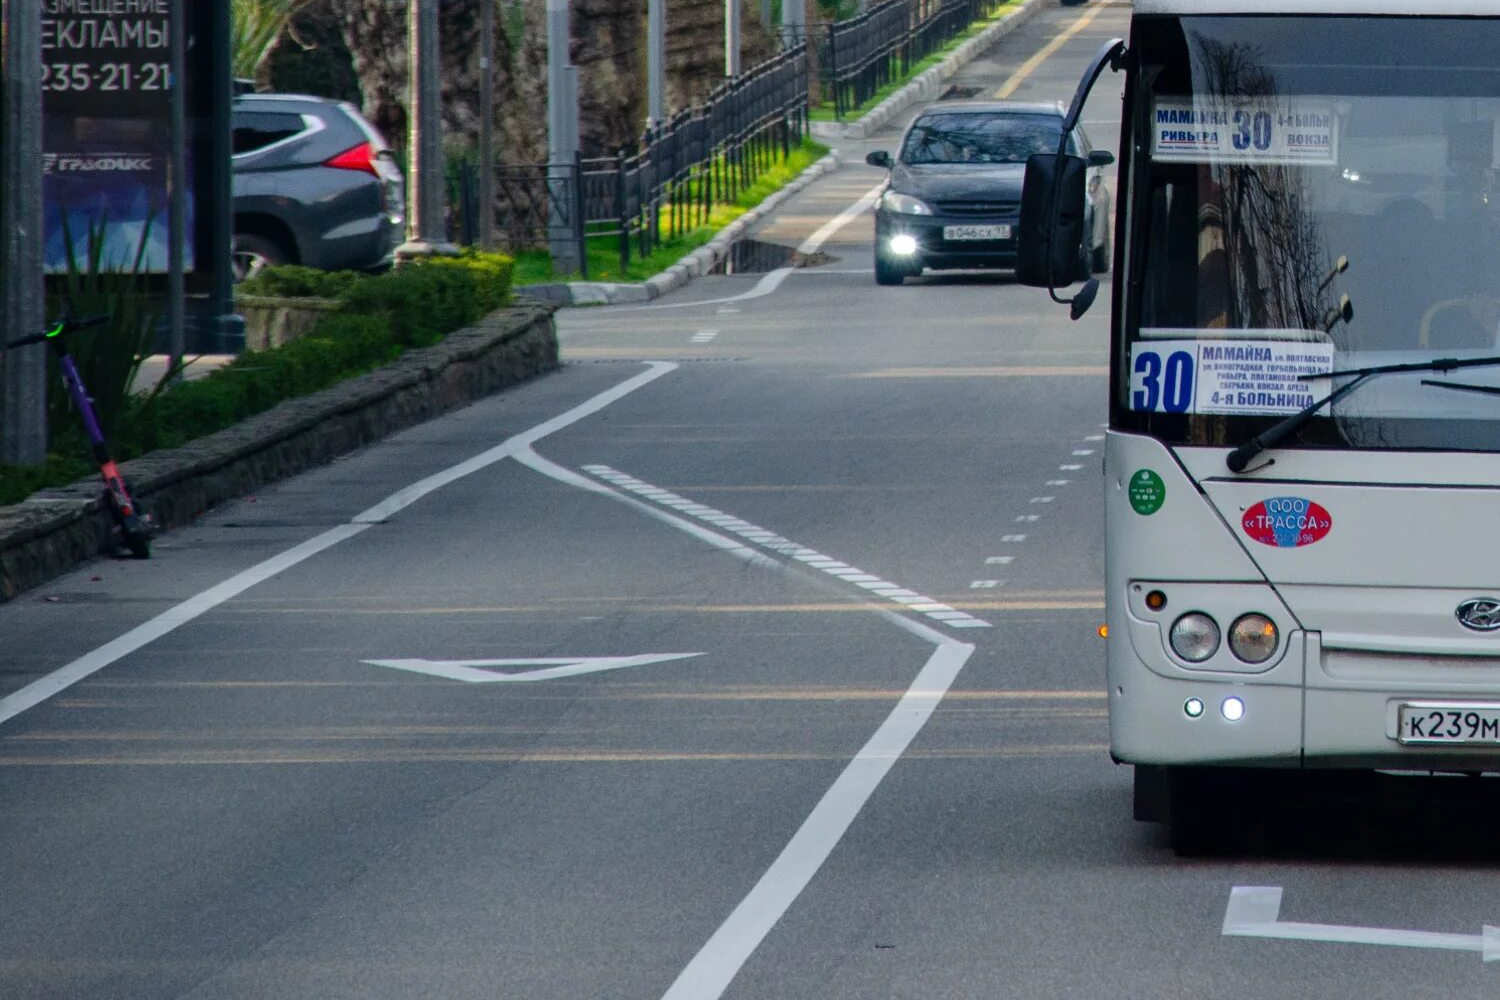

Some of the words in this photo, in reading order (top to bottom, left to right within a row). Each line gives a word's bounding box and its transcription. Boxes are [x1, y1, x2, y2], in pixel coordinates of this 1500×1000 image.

[1232, 109, 1273, 151] 30
[1203, 345, 1272, 361] МАМАЙКА
[1133, 351, 1194, 413] 30
[1212, 391, 1234, 405] 4-я
[1237, 392, 1314, 409] БОЛЬНИЦА
[1269, 499, 1304, 514] ООО
